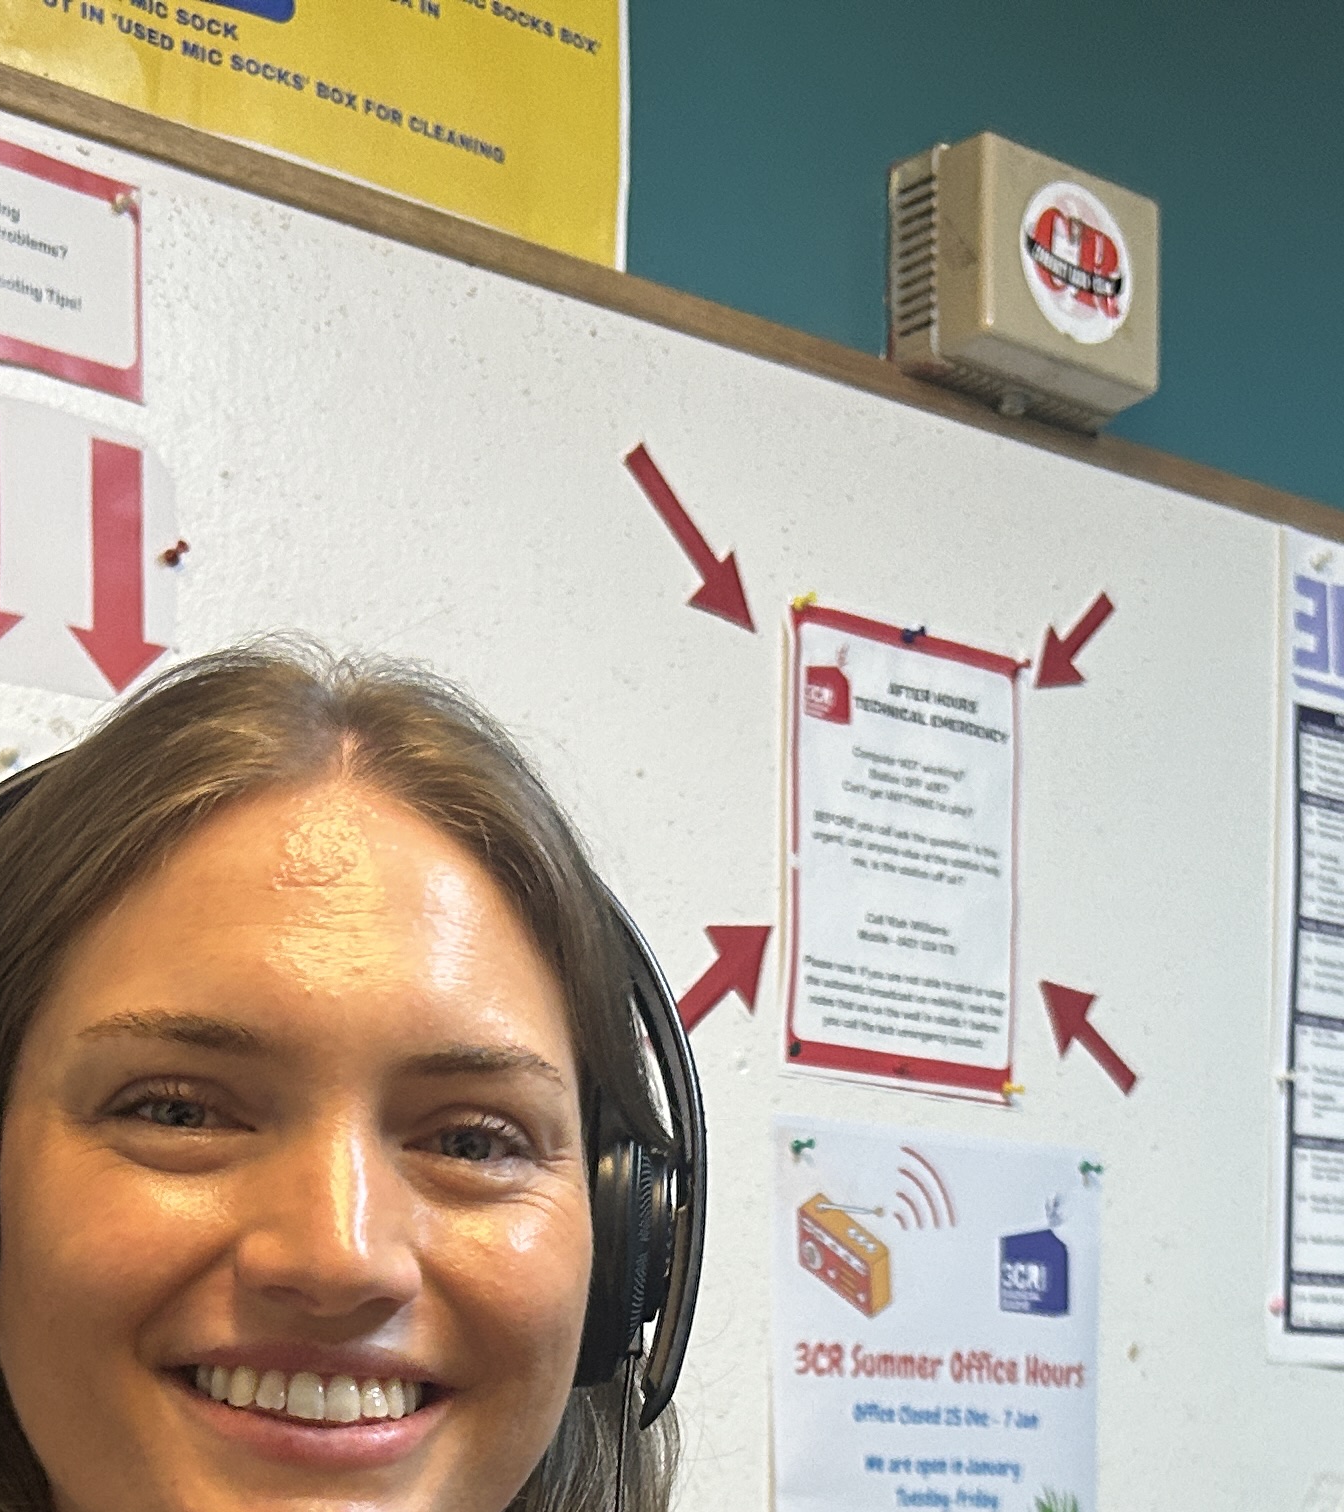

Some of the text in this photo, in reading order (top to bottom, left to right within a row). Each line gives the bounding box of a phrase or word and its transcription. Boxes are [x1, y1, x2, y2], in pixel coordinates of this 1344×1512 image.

[175, 7, 238, 41] SOCK
[80, 1, 104, 25] IN
[181, 39, 223, 66] MIC
[316, 81, 358, 112] BOX
[362, 97, 404, 127] FOR
[408, 115, 504, 164] CLEANING
[794, 1341, 1085, 1388] 3CR Summer Office Hours
